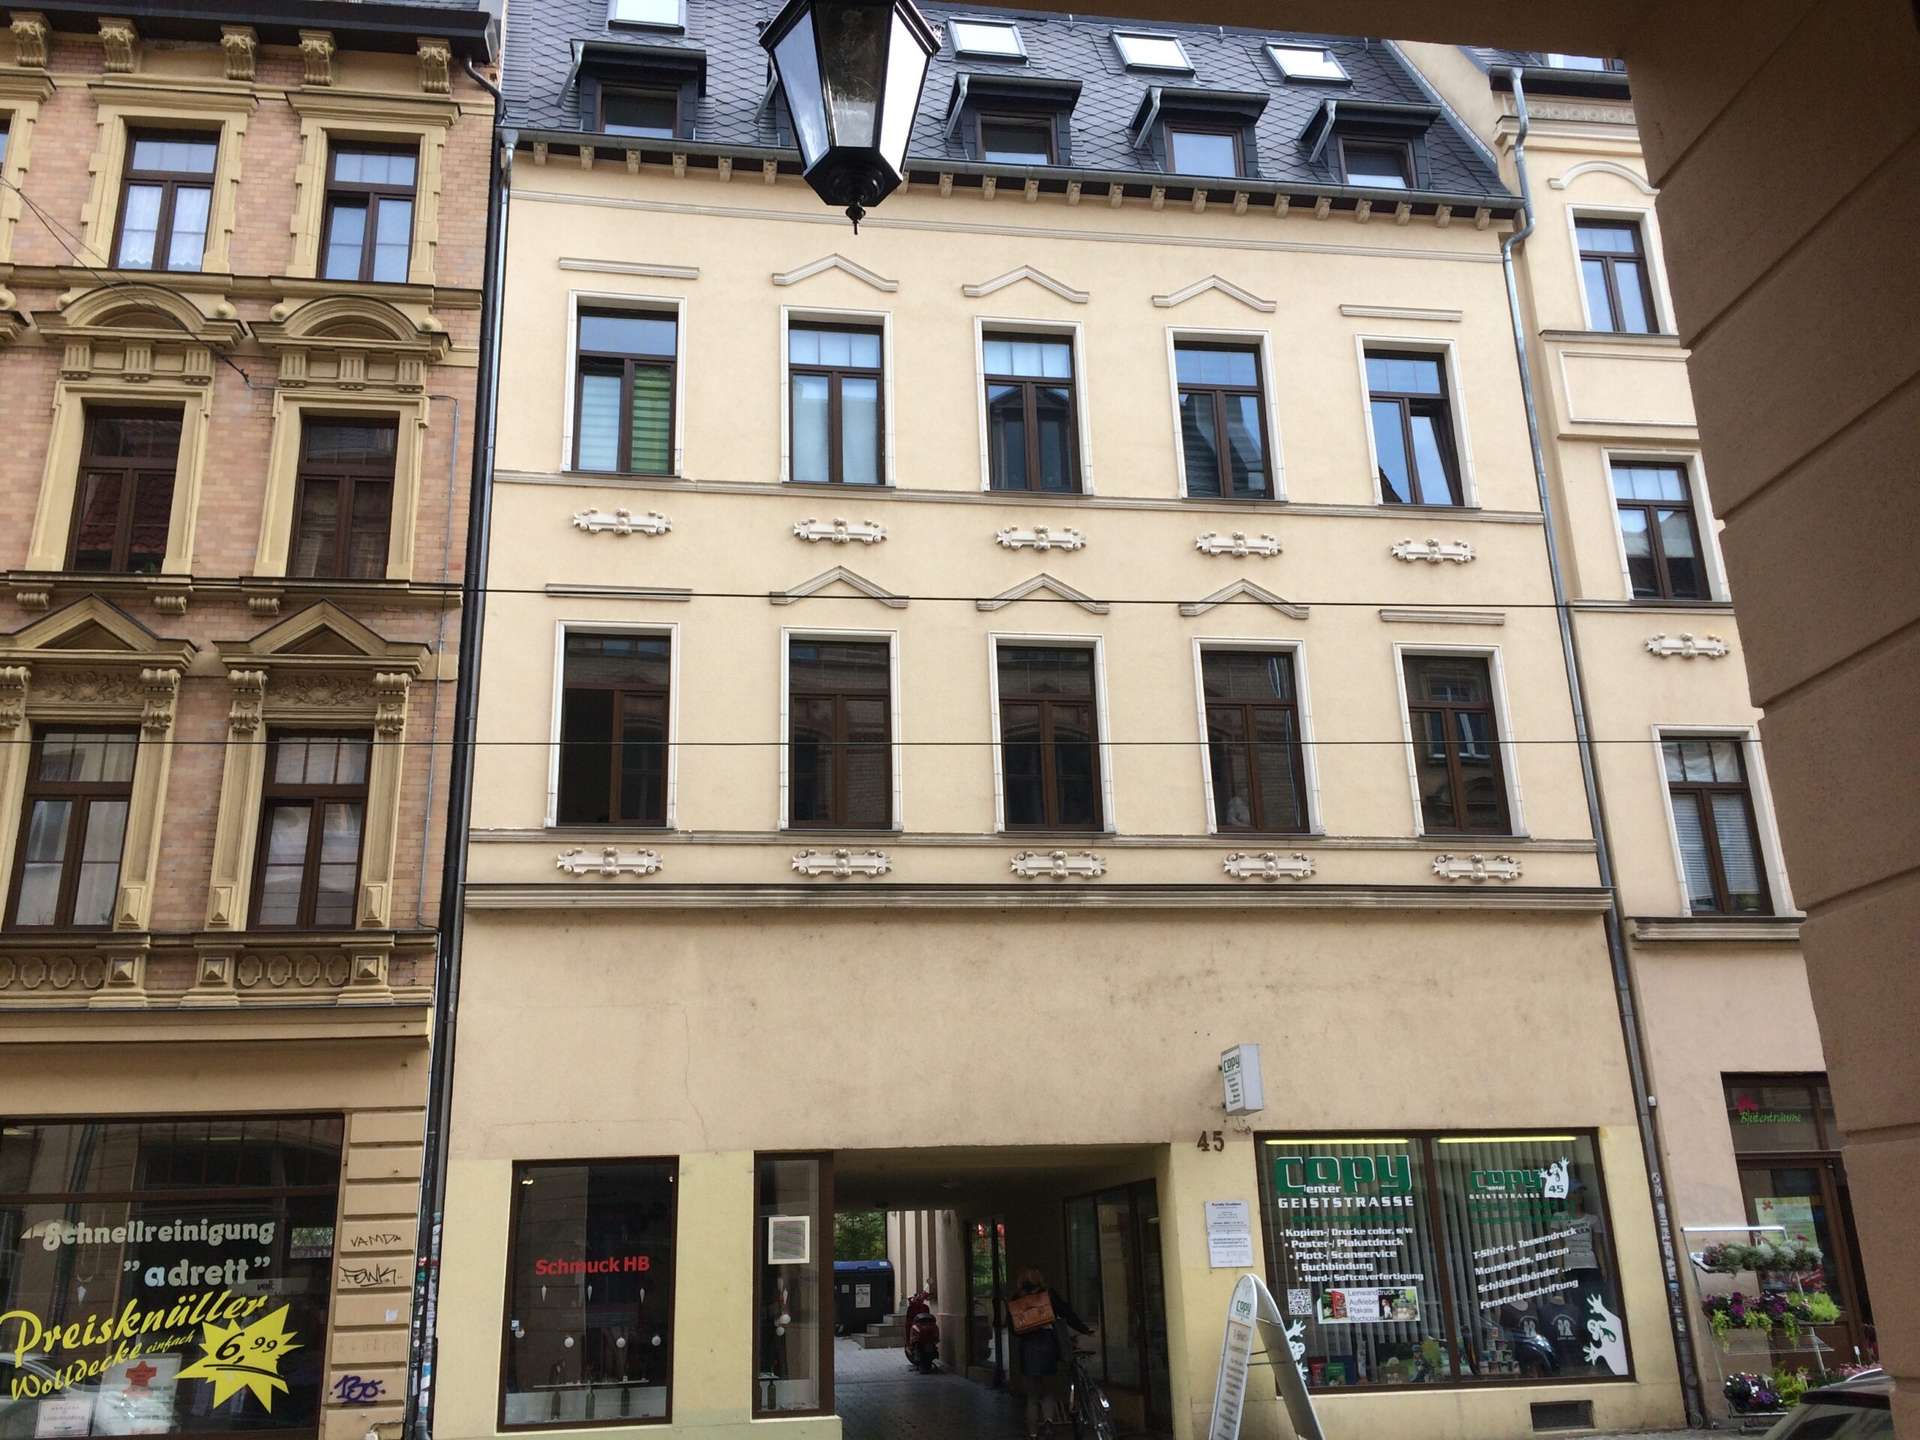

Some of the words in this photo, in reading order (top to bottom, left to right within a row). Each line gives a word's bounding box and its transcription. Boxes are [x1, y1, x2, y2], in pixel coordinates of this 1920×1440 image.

[1197, 1130, 1225, 1152] 45
[1548, 1185, 1564, 1194] 45
[1277, 1196, 1414, 1209] GEISTSTRASSE
[43, 1219, 276, 1251] Schnellreinigung
[1331, 1228, 1366, 1236] Drucke
[1518, 1227, 1577, 1249] Tassendruck
[1337, 1238, 1404, 1248] Plakatdruck
[1331, 1250, 1397, 1259] Scanservice
[535, 1257, 620, 1276] Schmuck
[623, 1256, 650, 1272] HB
[1301, 1262, 1374, 1271] Buchbindung
[1333, 1273, 1424, 1282] Softcoverfertigung
[1477, 1266, 1560, 1293] Schlüsselbänder
[1480, 1280, 1579, 1310] Fensterbeschriftung
[0, 1289, 269, 1368] Preisknüller
[11, 1341, 142, 1401] Wolldecke
[146, 1329, 195, 1354] einfach
